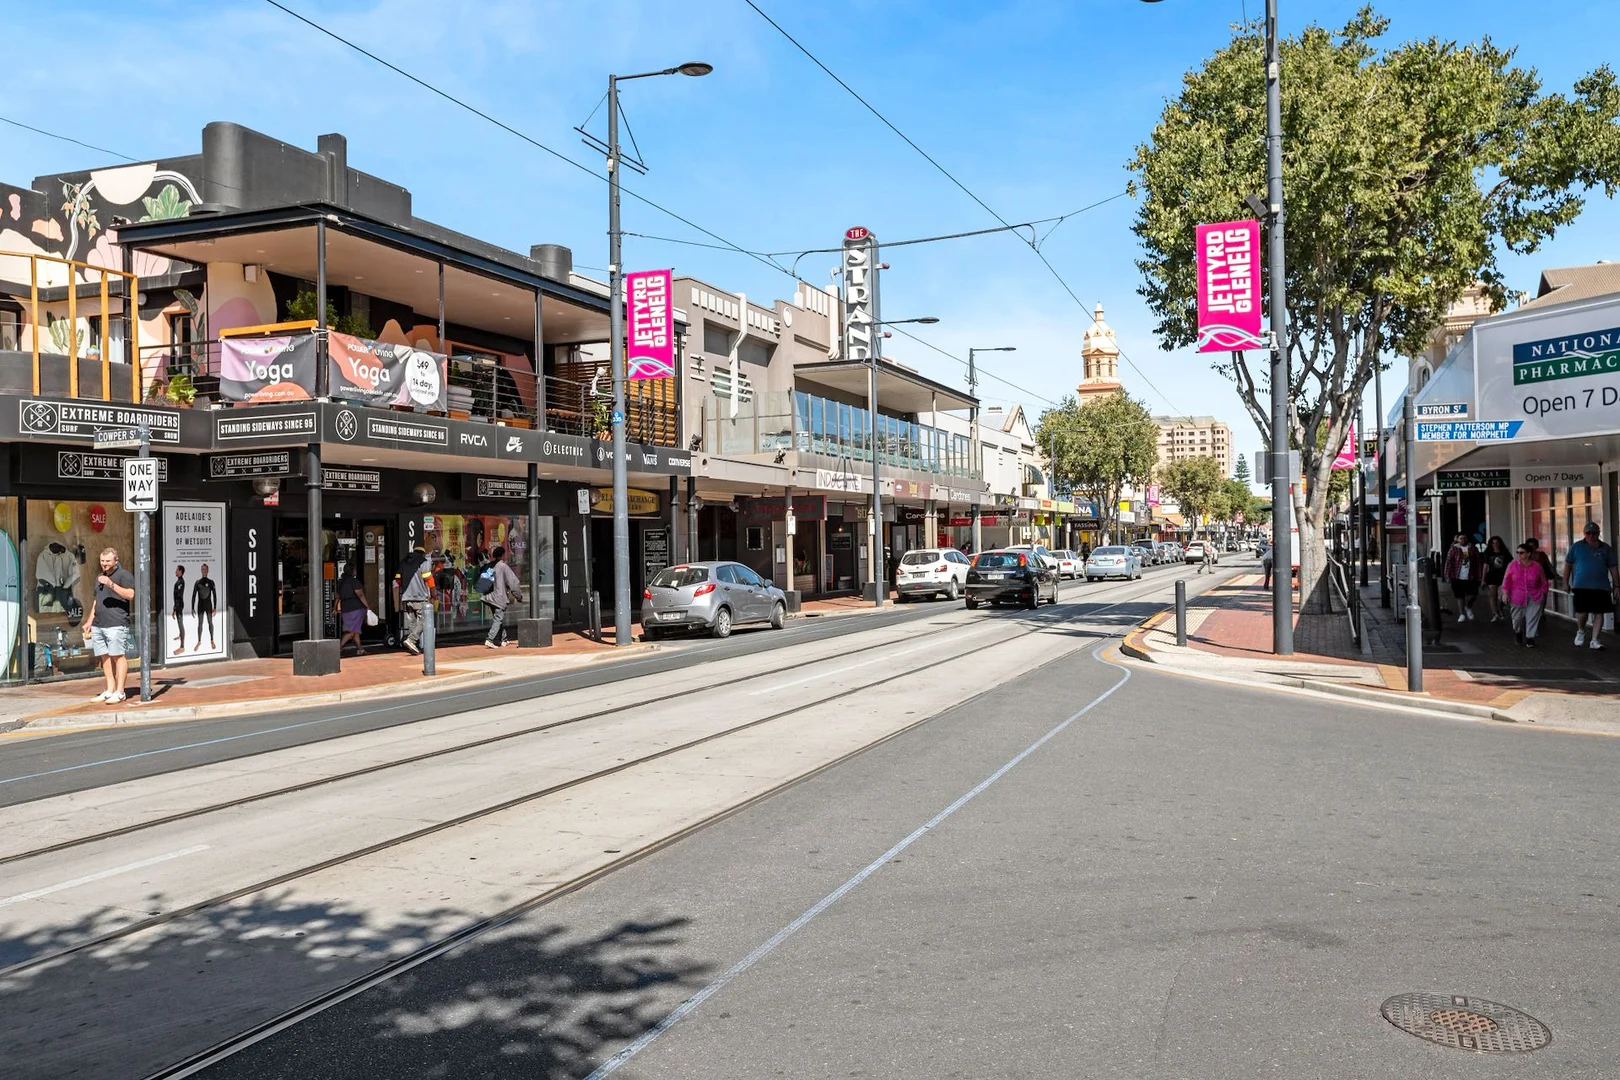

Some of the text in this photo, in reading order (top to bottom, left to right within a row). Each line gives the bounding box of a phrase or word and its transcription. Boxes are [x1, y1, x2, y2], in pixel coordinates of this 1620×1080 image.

[850, 228, 864, 238] THE
[1224, 228, 1252, 313] GLENELG
[846, 244, 872, 360] STRAND
[646, 275, 667, 347] GLENELG
[245, 360, 294, 385] Yoga
[348, 358, 390, 386] Yoga
[1523, 386, 1620, 418] Open 7 D
[1422, 406, 1450, 415] BYRON
[62, 406, 178, 428] EXTREME BOARDRIDERS
[62, 425, 79, 433] SURF
[220, 418, 313, 434] STANDING SIDEWAYS SINCE 95
[372, 423, 398, 435] STANDING
[398, 426, 423, 438] SIDEWAYS
[423, 429, 437, 440] SINCE
[1420, 423, 1452, 432] STEPHEN
[1454, 423, 1494, 431] PATTERSON
[98, 430, 127, 442] COWPER
[460, 433, 488, 447] RVCA
[1422, 430, 1508, 440] MEMBER FOR MORPHETT
[553, 446, 584, 456] ELECTRIC
[606, 451, 632, 461] VOM
[84, 456, 118, 468] EXTREME
[227, 454, 288, 467] EXTREME BOARDRIDERS
[643, 453, 658, 466] VANS
[668, 457, 691, 468] CONVERSE
[130, 464, 152, 476] ONE
[1446, 470, 1501, 479] NATIONAL
[326, 471, 379, 482] EXTREME BOARDRIDERS
[1525, 472, 1584, 483] Open 7 Days
[128, 479, 154, 492] WAY
[1440, 480, 1509, 488] PHARMACIES
[950, 489, 971, 501] Cardones
[92, 514, 106, 523] SALE
[175, 512, 212, 521] ADELAIDE'S
[248, 528, 257, 618] SURF
